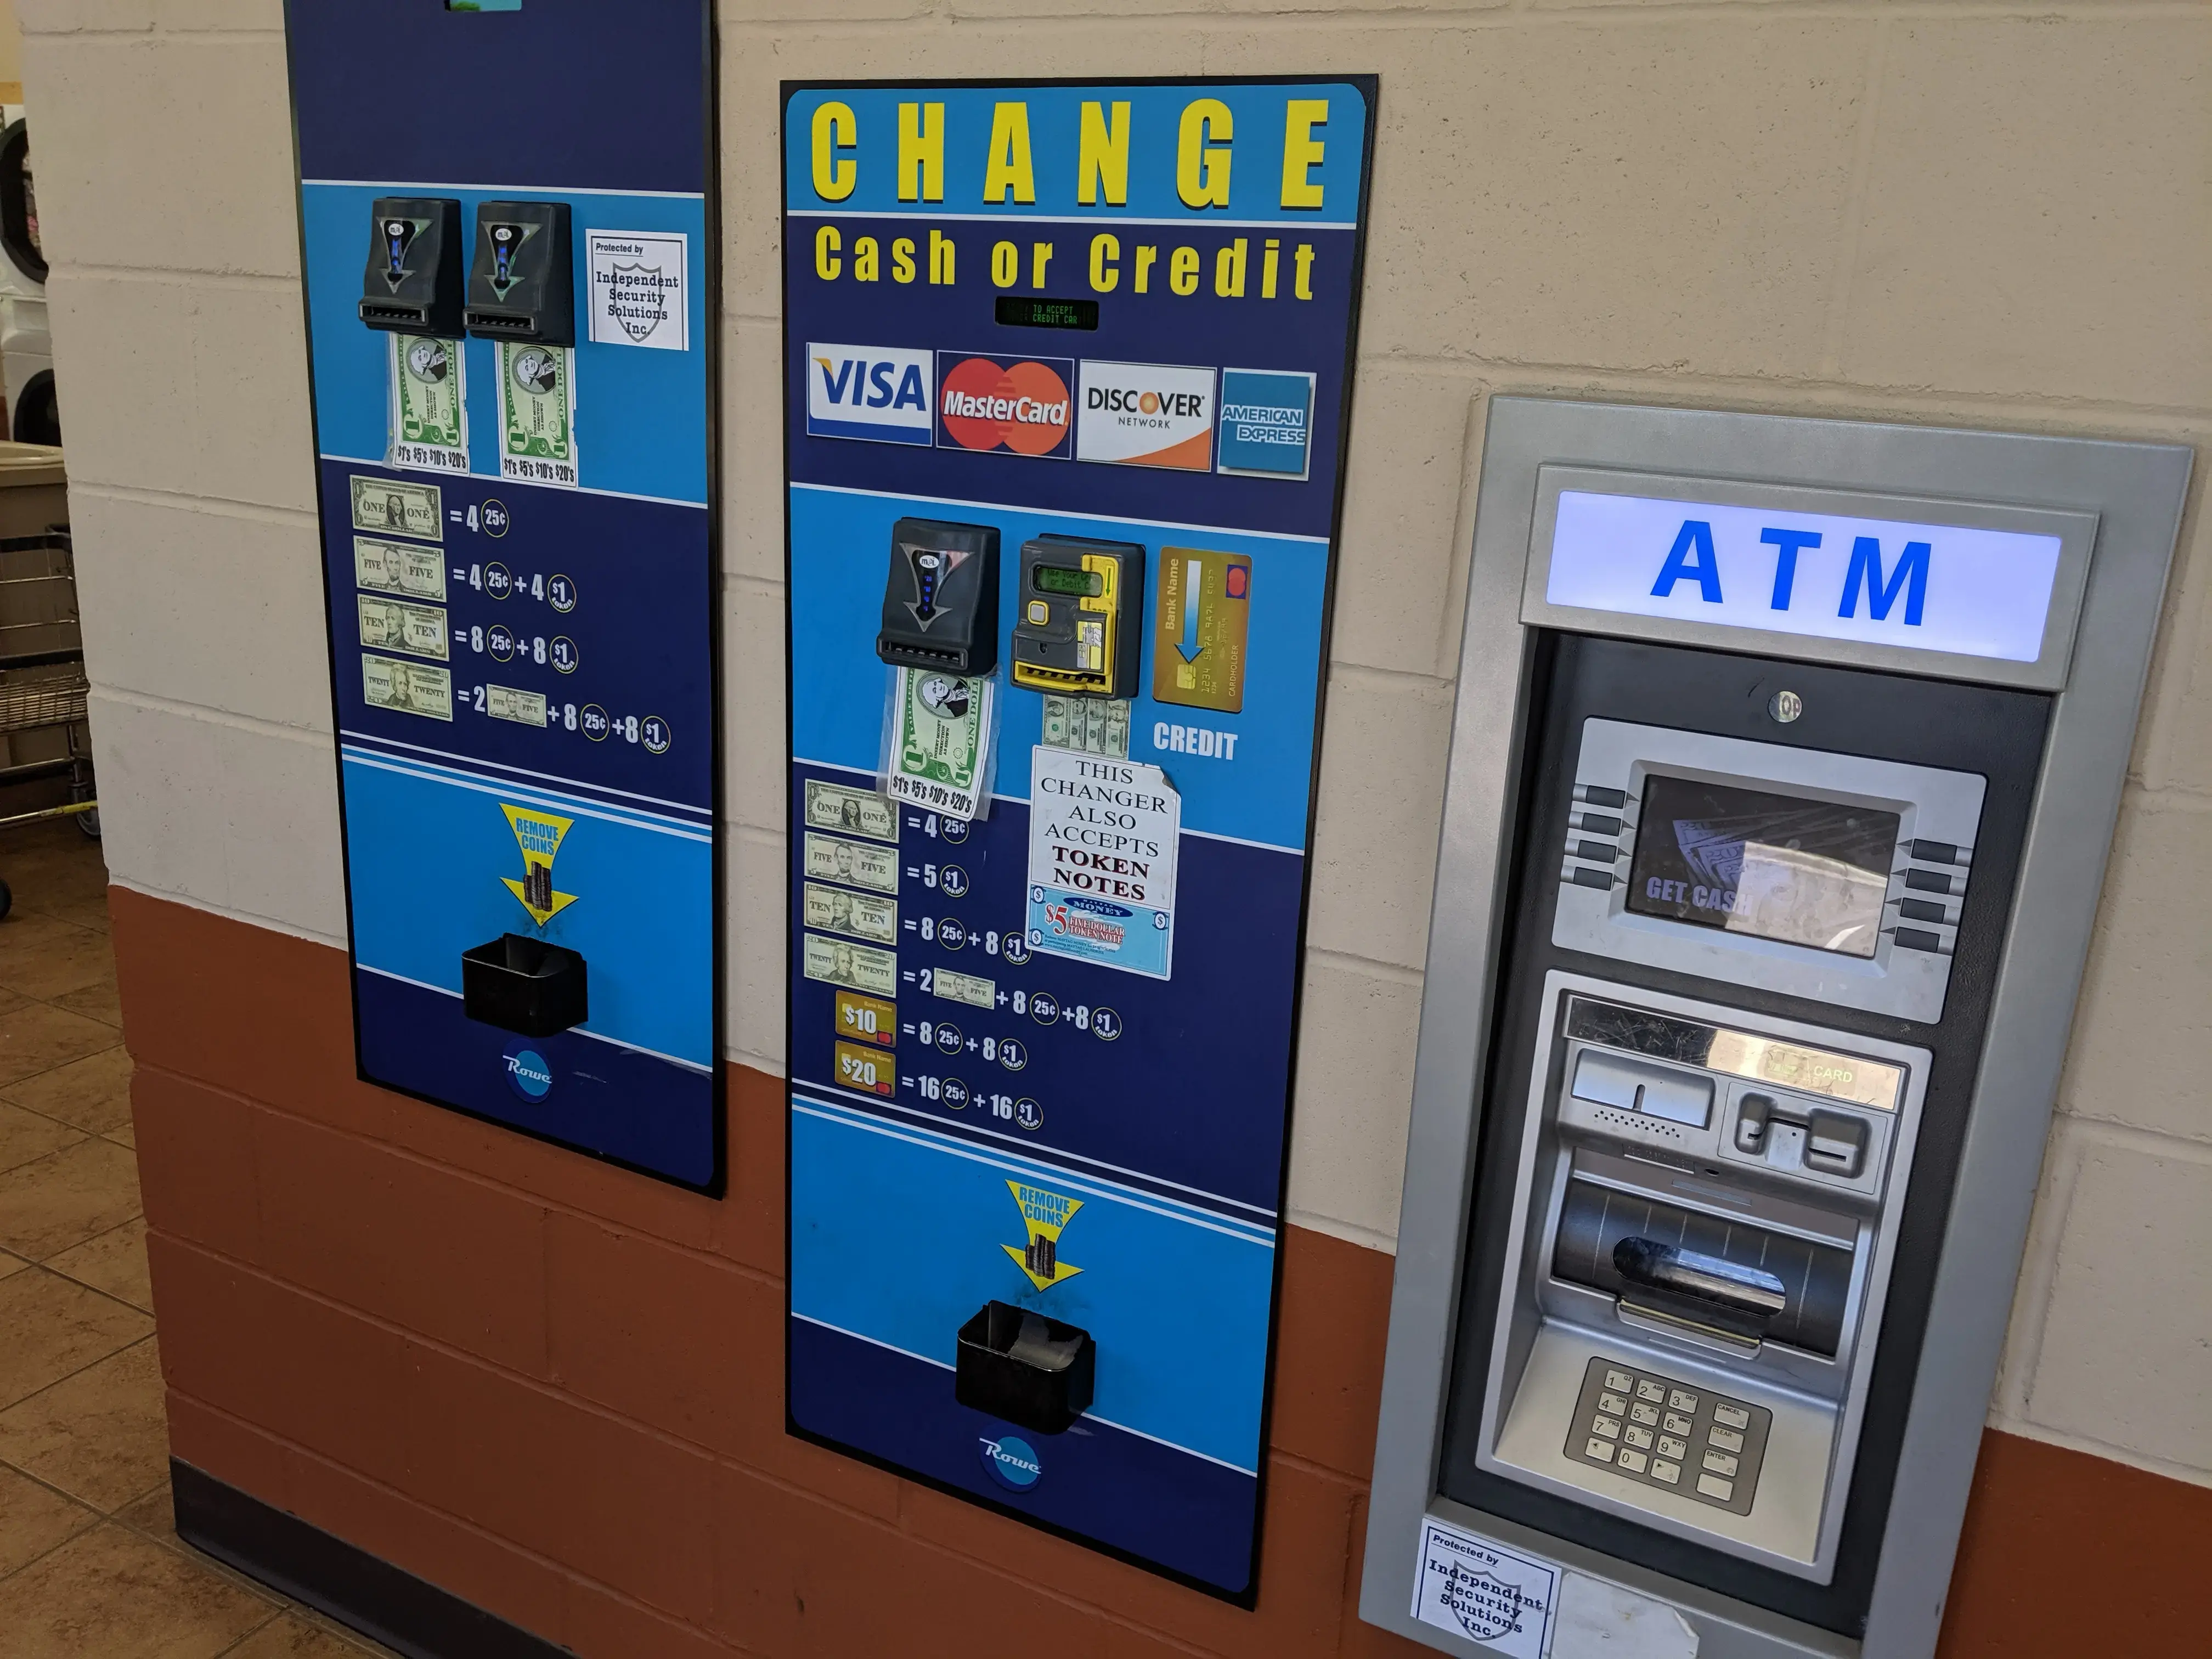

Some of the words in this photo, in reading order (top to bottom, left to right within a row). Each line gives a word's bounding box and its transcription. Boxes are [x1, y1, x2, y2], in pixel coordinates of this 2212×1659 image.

[811, 98, 1330, 210] CHANGE
[596, 242, 632, 252] Protected
[635, 245, 643, 255] by
[815, 225, 955, 285] Cash
[992, 241, 1053, 289] or
[1090, 233, 1315, 300] Credit
[596, 271, 678, 287] Independent
[610, 289, 665, 306] Security
[608, 304, 668, 320] Solutions
[1033, 314, 1059, 323] CREDIT
[1034, 304, 1042, 313] TO
[1047, 306, 1073, 314] ACCEPT
[626, 322, 650, 335] Inc.
[812, 358, 927, 411] VISA
[944, 391, 1068, 426] MasterCard
[1088, 387, 1202, 417] DISCOVER
[1119, 417, 1170, 429] NETWORK
[1222, 404, 1303, 426] AMERICAN
[1237, 425, 1305, 445] EXPRESS
[398, 445, 410, 461] $1's
[414, 446, 427, 464] $5's
[430, 449, 446, 466] $10's
[448, 451, 466, 469] $20's
[505, 458, 517, 475] $1's
[520, 460, 533, 477] $5's
[536, 462, 553, 479] $10's
[556, 464, 574, 482] $20's
[363, 501, 385, 513] ONE
[407, 508, 430, 519] ONE
[364, 560, 381, 569] FIVE
[409, 566, 433, 578] FIVE
[1650, 520, 1932, 627] ATM
[1167, 558, 1179, 595] Name
[552, 582, 565, 602] $1
[364, 616, 385, 628] TEN
[1165, 599, 1176, 630] Bank
[414, 624, 436, 638] TEN
[555, 644, 567, 663] $1
[369, 676, 390, 686] TWENTY
[1201, 668, 1210, 693] 1234
[1229, 645, 1238, 697] CARDHOLDER
[414, 685, 445, 698] TWENTY
[523, 704, 538, 713] FIVE
[646, 723, 659, 743] $1
[968, 718, 976, 747] ONE
[1154, 722, 1238, 760] CREDIT
[1076, 760, 1133, 784] THIS
[893, 775, 909, 794] $1's
[912, 780, 927, 800] $5's
[929, 785, 949, 806] $10's
[951, 790, 972, 813] $20's
[1041, 778, 1167, 814] CHANGER
[817, 803, 840, 814] ONE
[863, 812, 887, 823] ONE
[1069, 805, 1136, 830] ALSO
[516, 817, 558, 841] REMOVE
[521, 834, 554, 856] COINS
[1045, 823, 1158, 857] ACCEPTS
[814, 851, 832, 863] FIVE
[1052, 845, 1150, 879] TOKEN
[861, 861, 886, 874] FIVE
[946, 871, 958, 888] $1
[1053, 867, 1145, 901] NOTES
[1646, 877, 1688, 903] GET
[1692, 885, 1753, 916] CASH
[809, 901, 831, 913] TEN
[1074, 900, 1123, 916] MONEY
[861, 911, 885, 925] TEN
[1045, 902, 1069, 935] $5
[1069, 917, 1088, 928] FIVE
[1091, 921, 1125, 936] DOLLAR
[1069, 926, 1097, 939] TOKEN
[1099, 933, 1123, 944] NOTE
[1008, 939, 1020, 956] $1
[809, 953, 832, 964] TWENTY
[857, 964, 890, 977] TWENTY
[970, 988, 986, 997] FIVE
[845, 1006, 877, 1035] $10
[1097, 1014, 1110, 1031] $1
[1003, 1045, 1017, 1062] $1
[503, 1055, 552, 1084] Rowe
[842, 1057, 876, 1086] $20
[1814, 1066, 1852, 1082] CARD
[1019, 1103, 1032, 1121] $1
[1019, 1186, 1070, 1215] REMOVE
[1025, 1206, 1064, 1228] COINS
[1609, 1376, 1615, 1386] 1
[1639, 1386, 1648, 1396] 2
[1673, 1396, 1680, 1406] 3
[1602, 1400, 1610, 1409] 4
[1634, 1409, 1641, 1419] 5
[1667, 1419, 1674, 1429] 6
[1717, 1404, 1740, 1416] CANCEL
[1596, 1421, 1604, 1431] 7
[1627, 1432, 1635, 1442] 8
[1661, 1442, 1668, 1452] 9
[1672, 1440, 1686, 1448] WXY
[1712, 1427, 1733, 1437] CLEAR
[979, 1438, 1042, 1475] Rowe
[1622, 1453, 1629, 1463] 0
[1706, 1451, 1726, 1461] ENTER
[1433, 1534, 1483, 1559] Protected
[1487, 1554, 1499, 1565] by
[1429, 1559, 1543, 1611] Independent
[1444, 1580, 1522, 1618] Security
[1440, 1593, 1522, 1633] Solutions
[1463, 1616, 1496, 1638] Inc.
